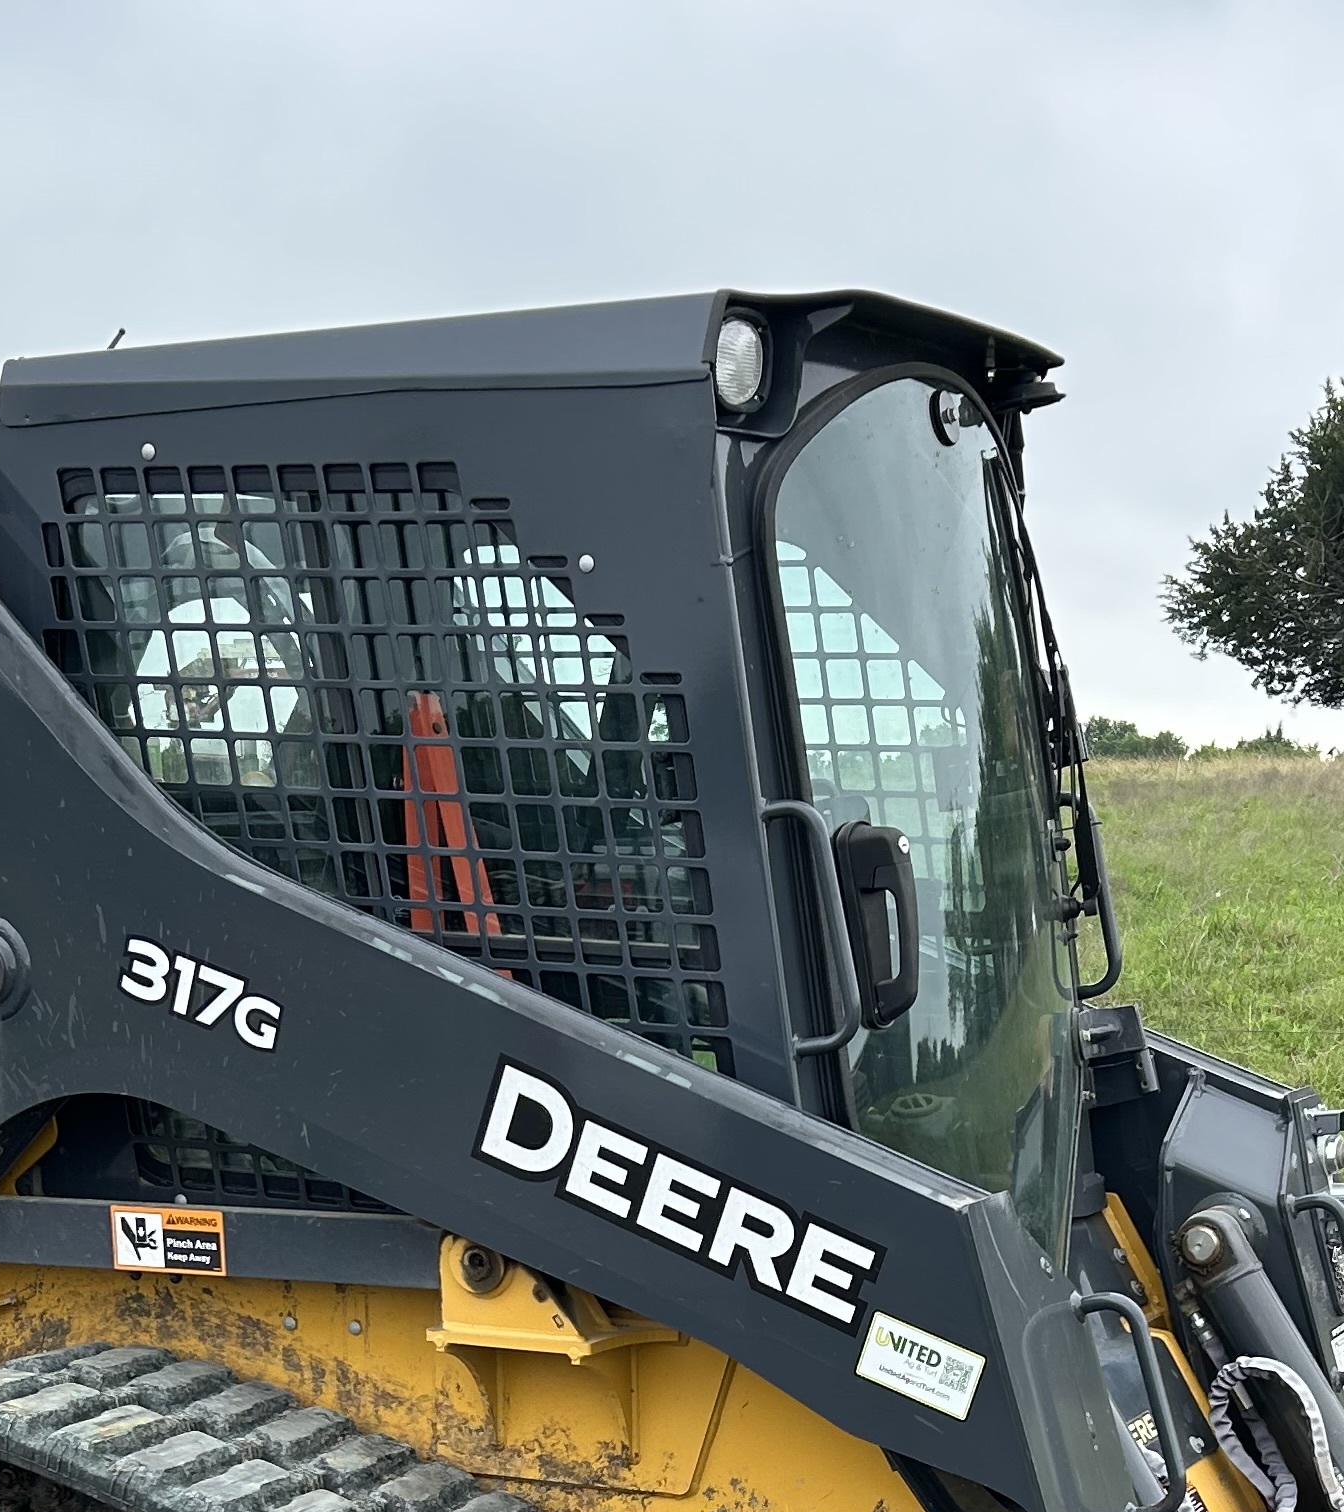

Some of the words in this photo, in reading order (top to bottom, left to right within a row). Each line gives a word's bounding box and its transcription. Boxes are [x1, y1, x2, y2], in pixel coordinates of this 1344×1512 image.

[120, 938, 282, 1051] 317G
[480, 1064, 877, 1323] DEERE
[175, 1215, 217, 1227] WARNING
[166, 1237, 193, 1248] Pinch
[195, 1240, 217, 1250] Area
[167, 1252, 188, 1262] Keep
[189, 1252, 211, 1264] Away
[875, 1325, 942, 1368] UNITED
[903, 1358, 915, 1370] Ag
[924, 1365, 938, 1378] Turf
